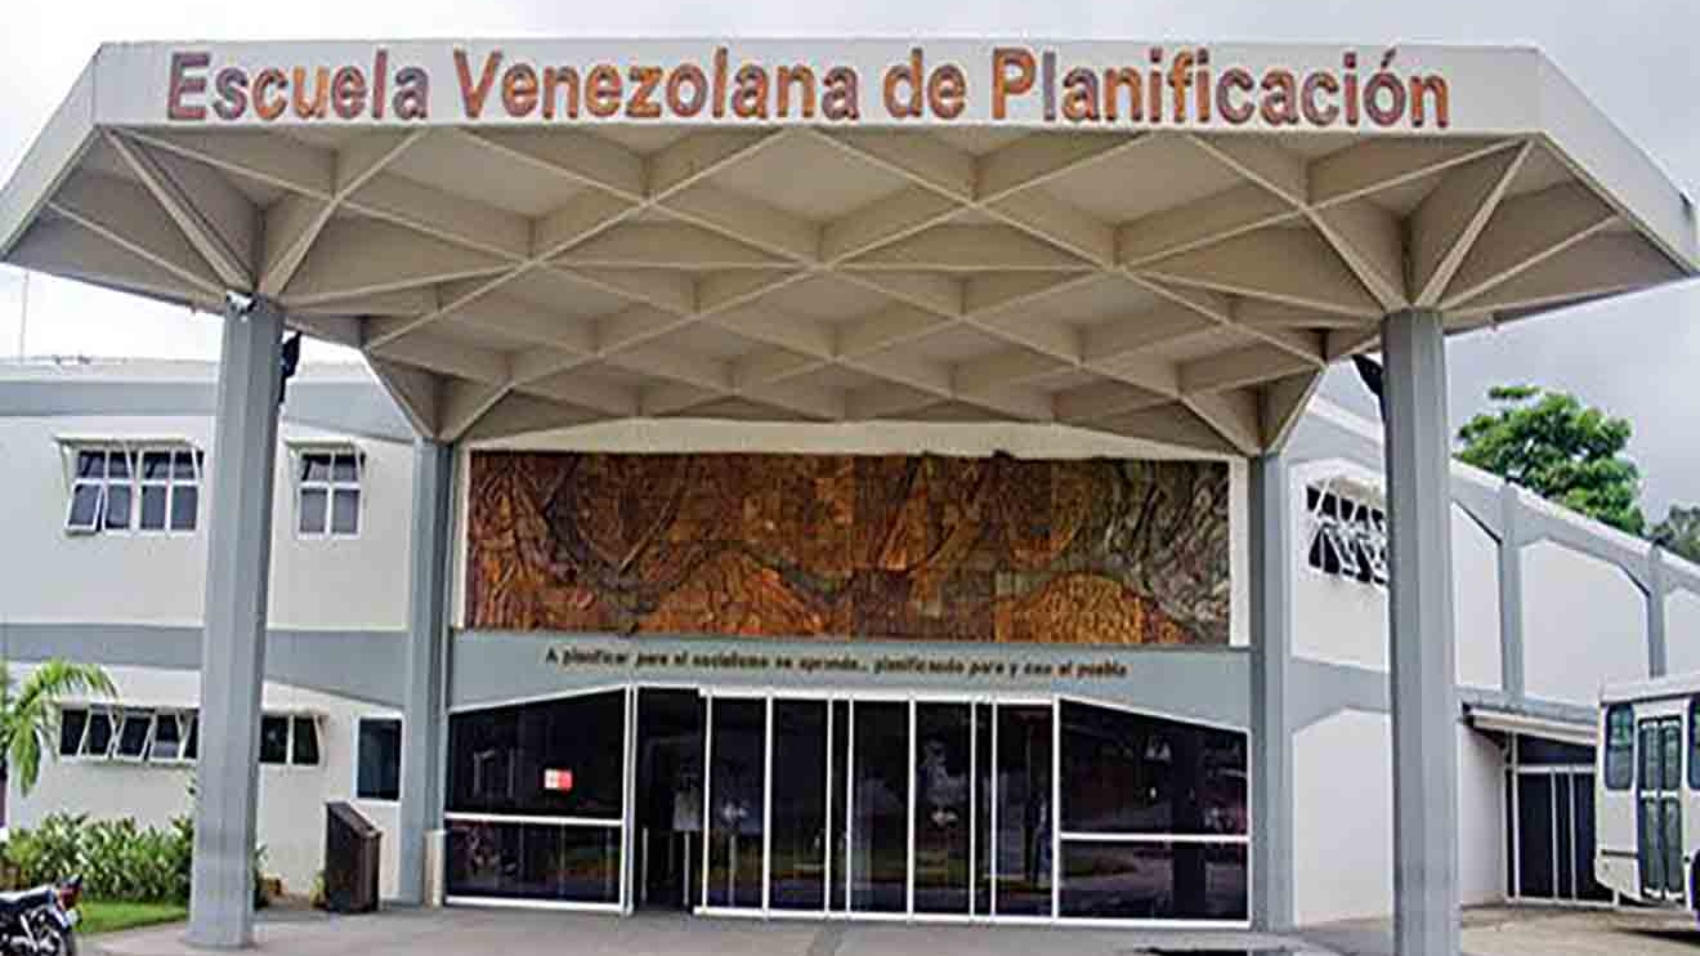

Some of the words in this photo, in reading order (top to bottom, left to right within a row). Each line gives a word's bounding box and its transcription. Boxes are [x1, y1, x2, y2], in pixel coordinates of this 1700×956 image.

[166, 48, 429, 122] Escuela
[451, 48, 859, 122] Venezolana
[882, 48, 967, 120] de
[991, 46, 1450, 129] Planificación
